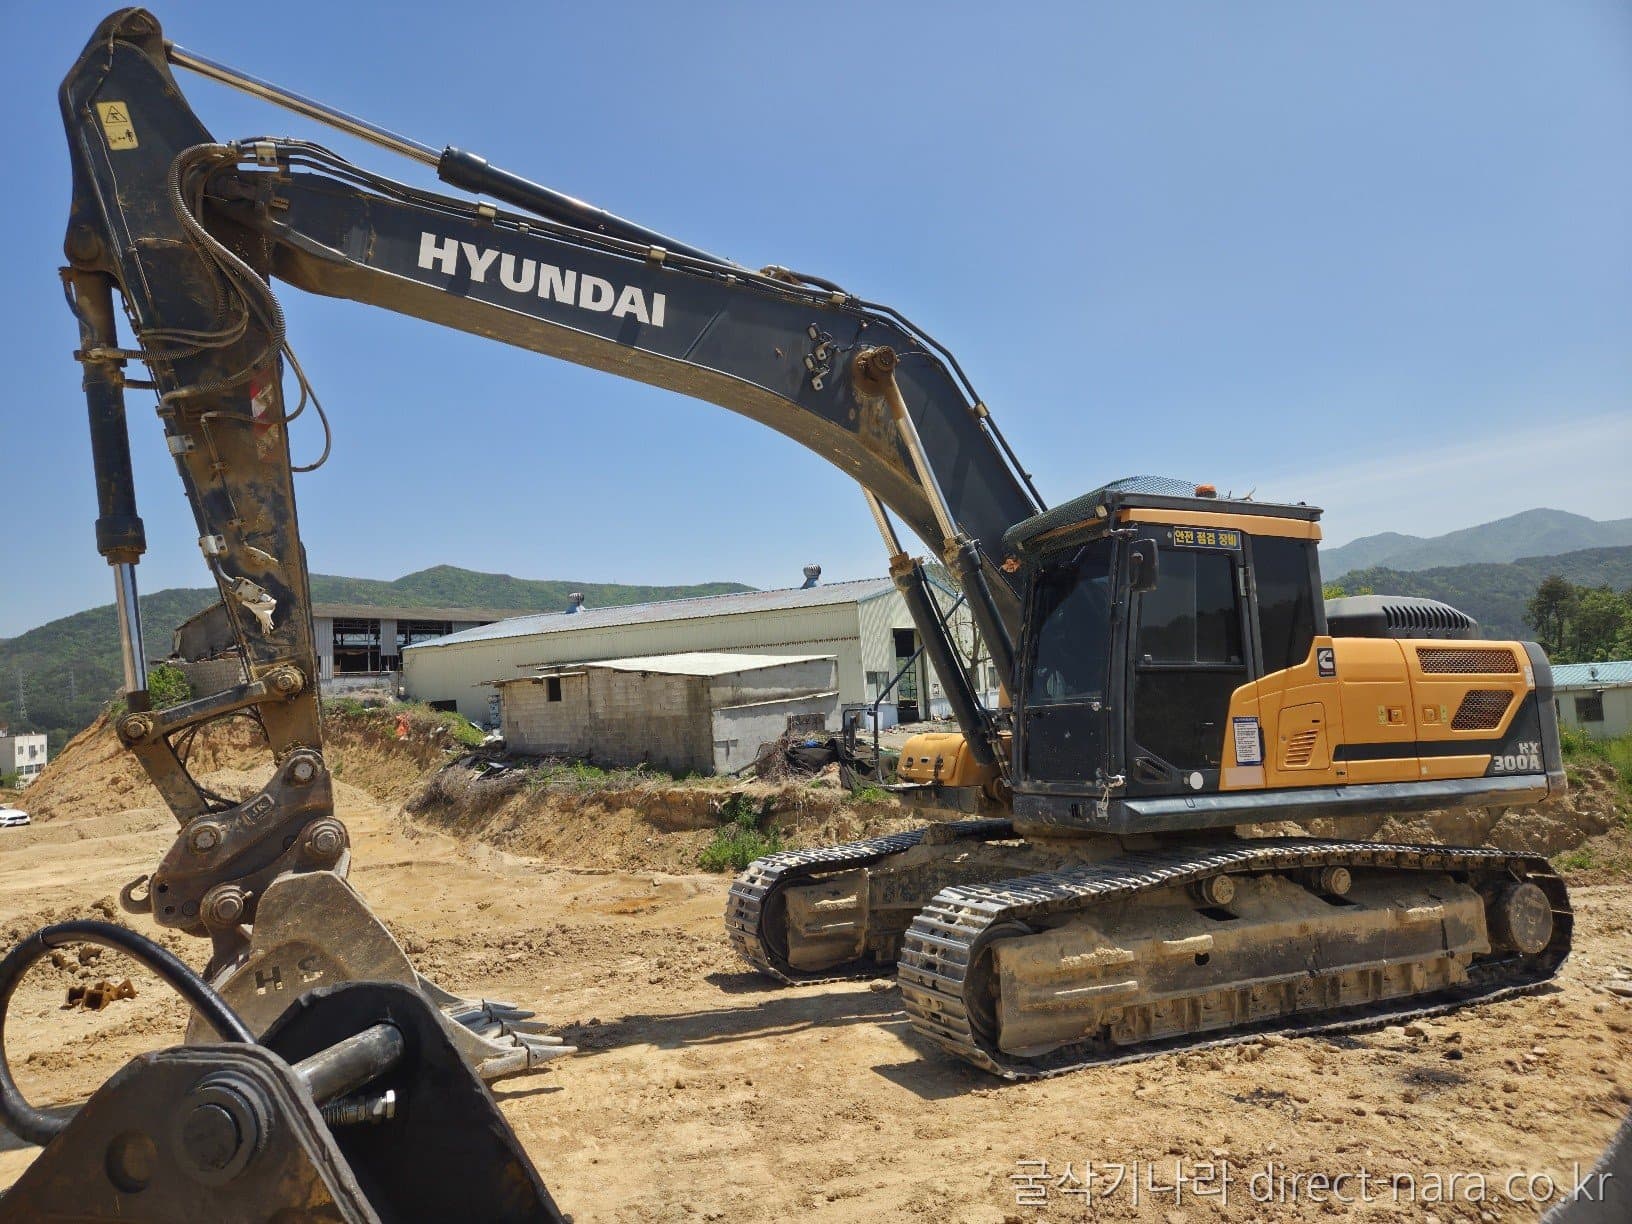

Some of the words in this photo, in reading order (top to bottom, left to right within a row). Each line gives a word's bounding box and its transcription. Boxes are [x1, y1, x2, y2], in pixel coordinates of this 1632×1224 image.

[417, 231, 666, 328] HYUNDAI
[1175, 530, 1194, 544] 안전
[1196, 531, 1216, 545] 점검
[1518, 742, 1540, 754] HX
[1493, 755, 1541, 771] 300A
